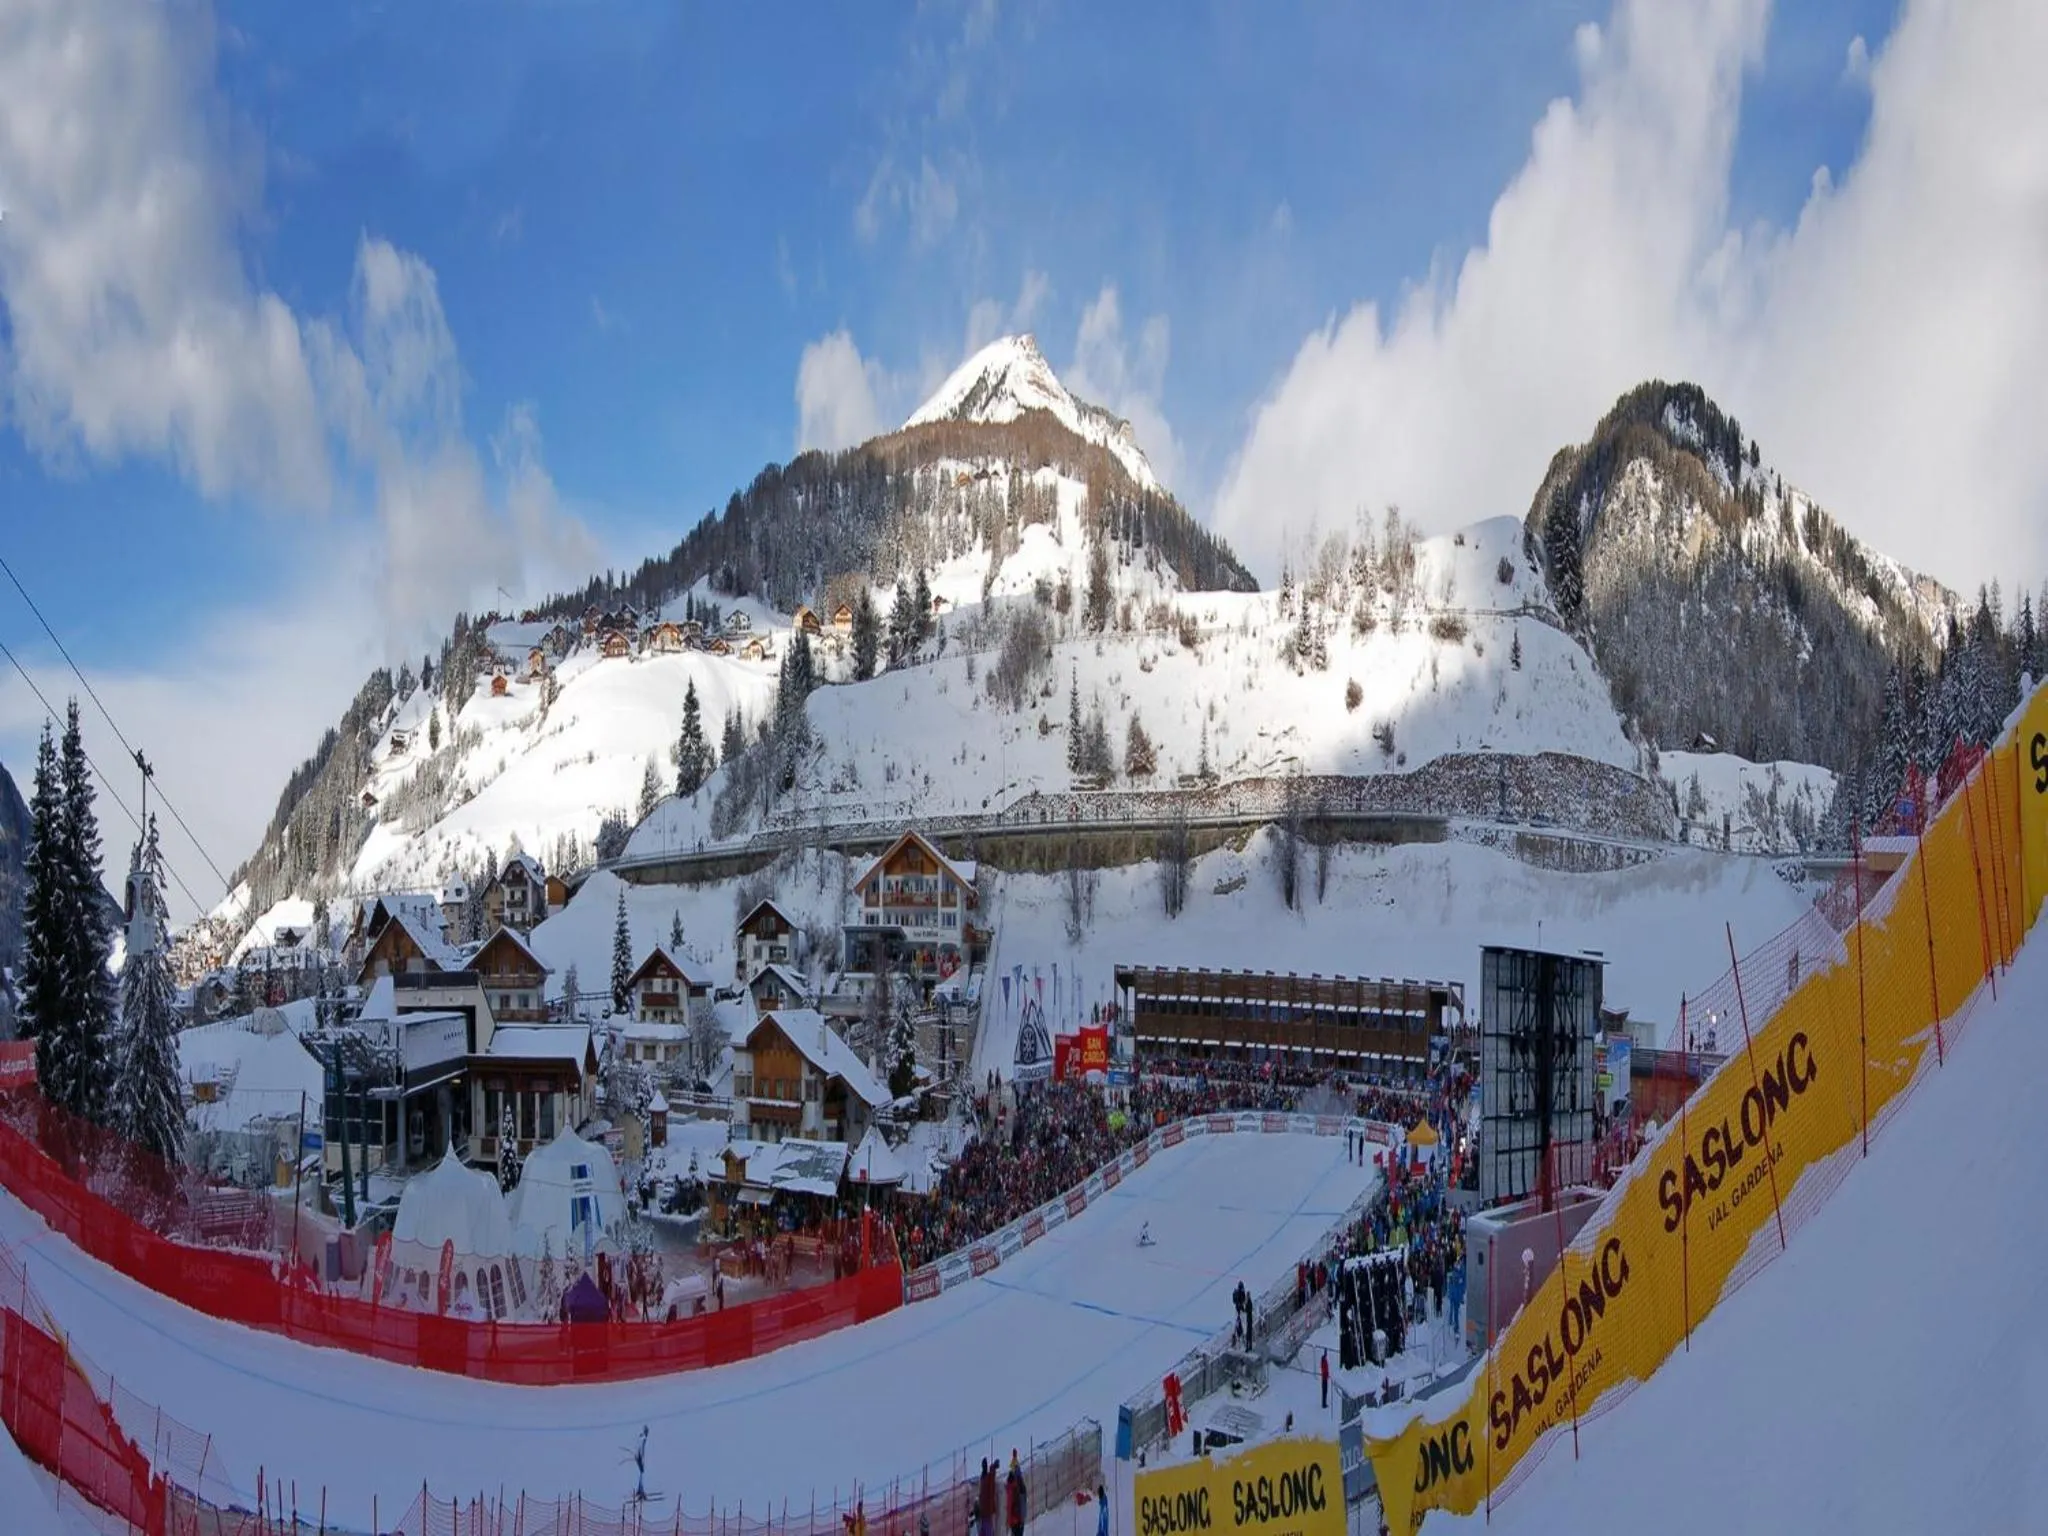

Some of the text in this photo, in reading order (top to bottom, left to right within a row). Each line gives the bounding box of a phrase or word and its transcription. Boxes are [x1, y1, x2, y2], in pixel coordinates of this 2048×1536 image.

[1658, 1032, 1817, 1233] SASLONG
[1707, 1142, 1784, 1231] VAL GARDENA
[1490, 1237, 1630, 1450] SASLONG
[1141, 1462, 1327, 1536] SASLONG SASLONG
